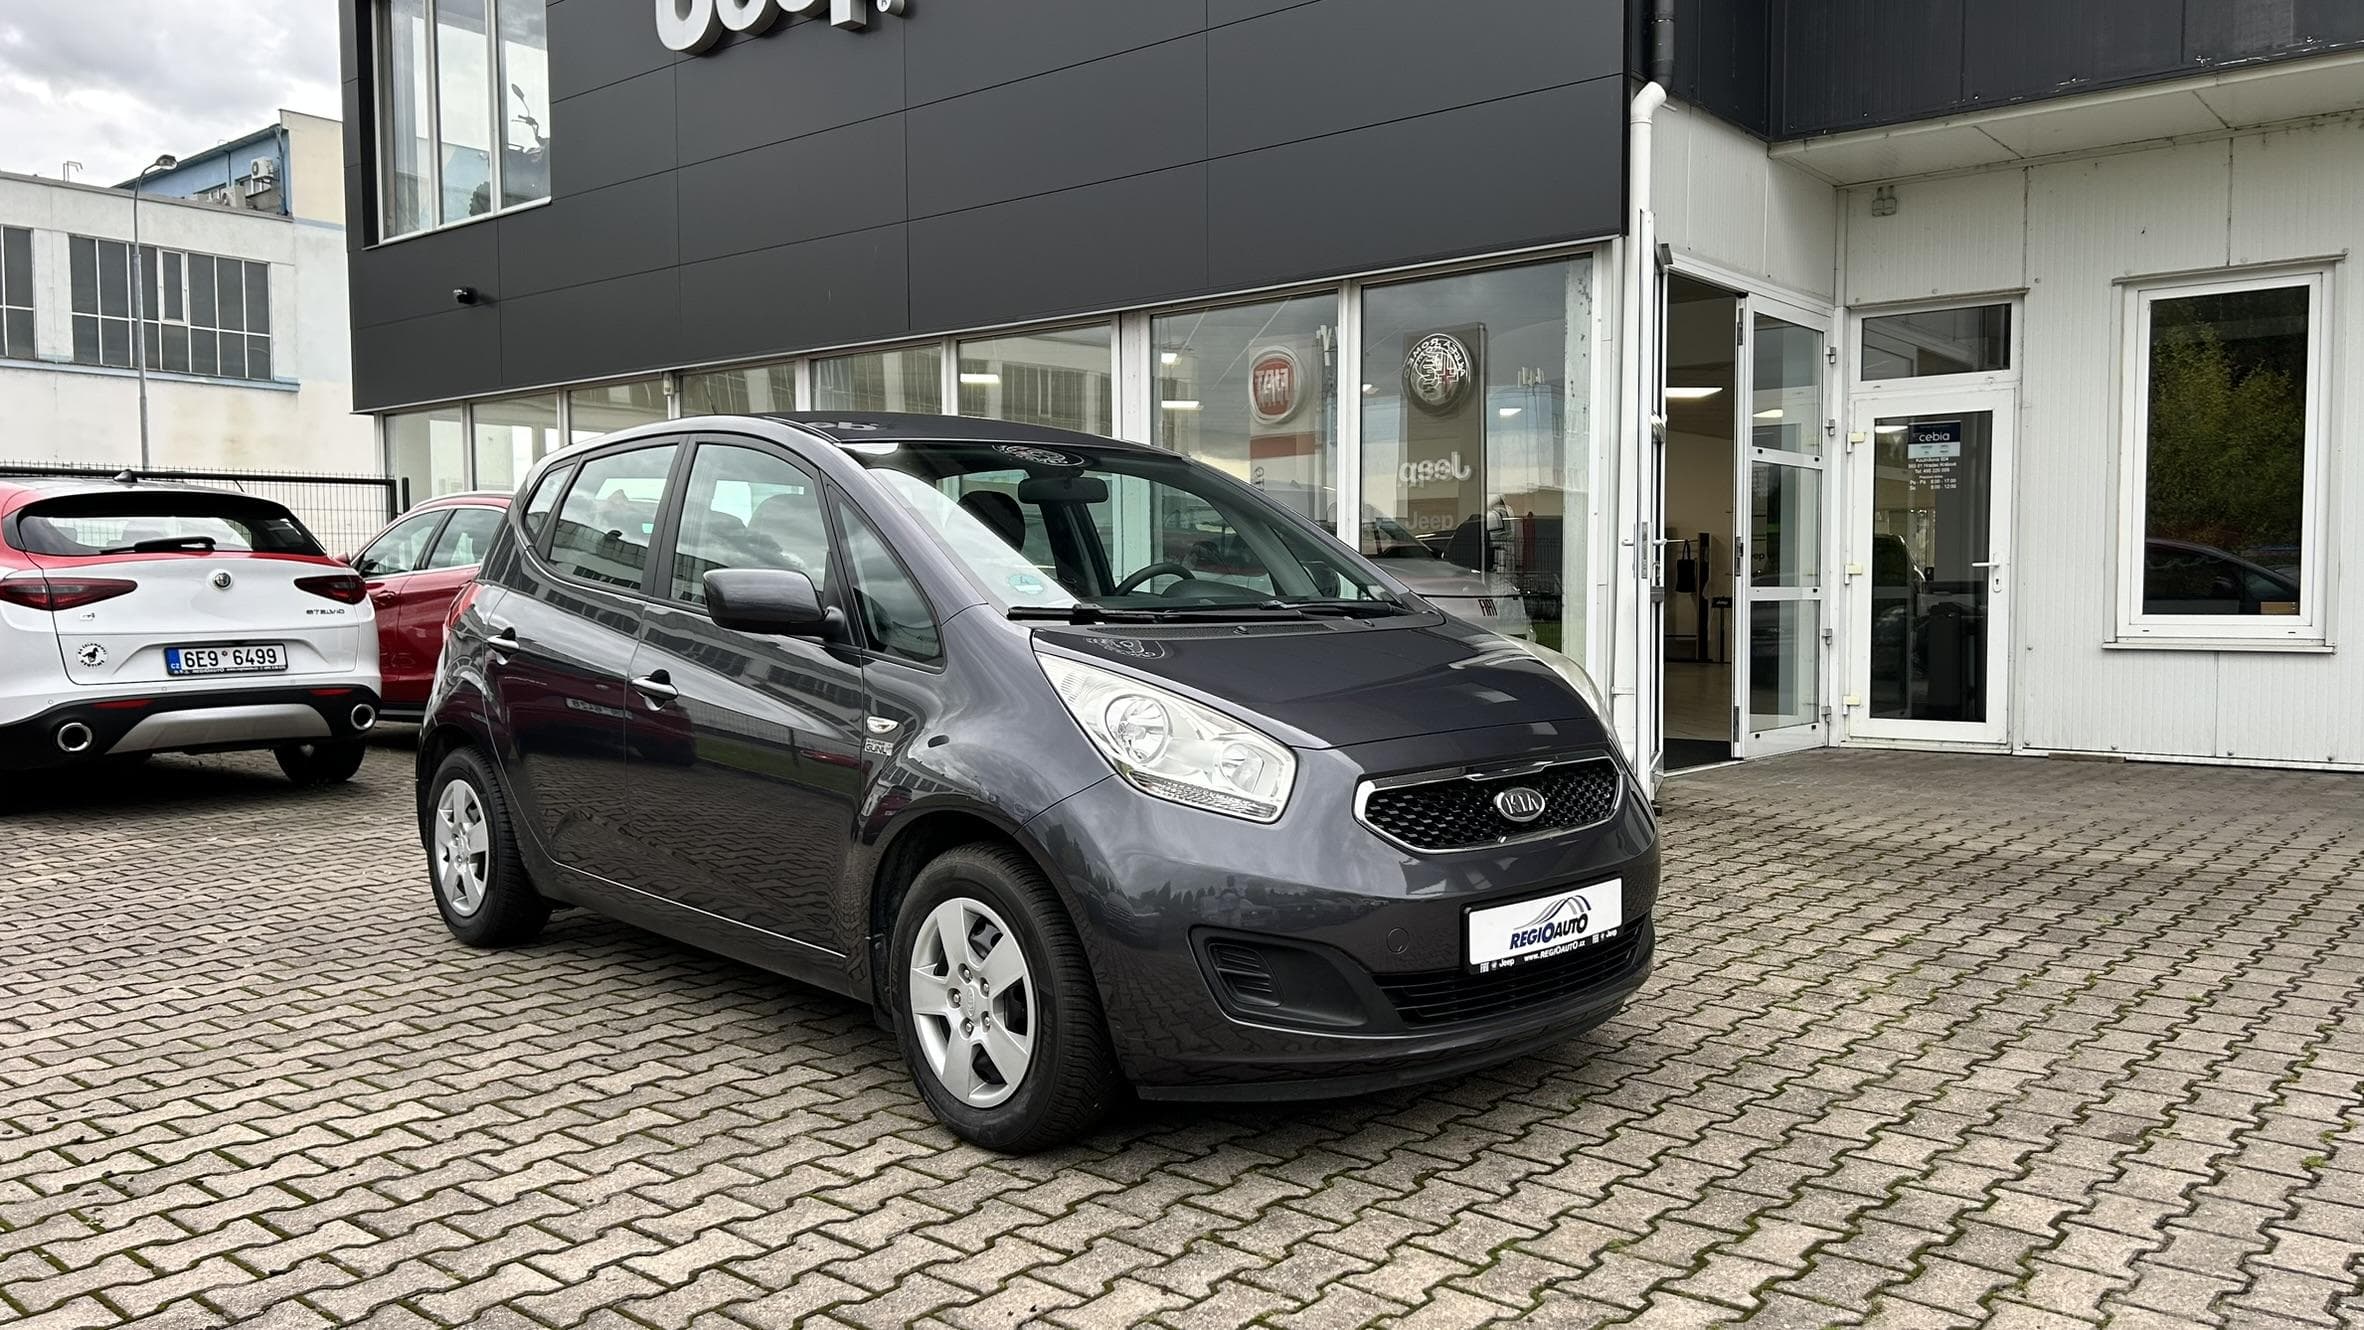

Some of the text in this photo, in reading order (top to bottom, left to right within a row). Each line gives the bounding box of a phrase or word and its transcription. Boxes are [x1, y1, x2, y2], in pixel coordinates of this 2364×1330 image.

[1919, 432, 1950, 442] cebia
[184, 648, 277, 668] 6E9 6499
[1504, 792, 1540, 814] KIA
[1509, 913, 1588, 950] REGIOAUTO
